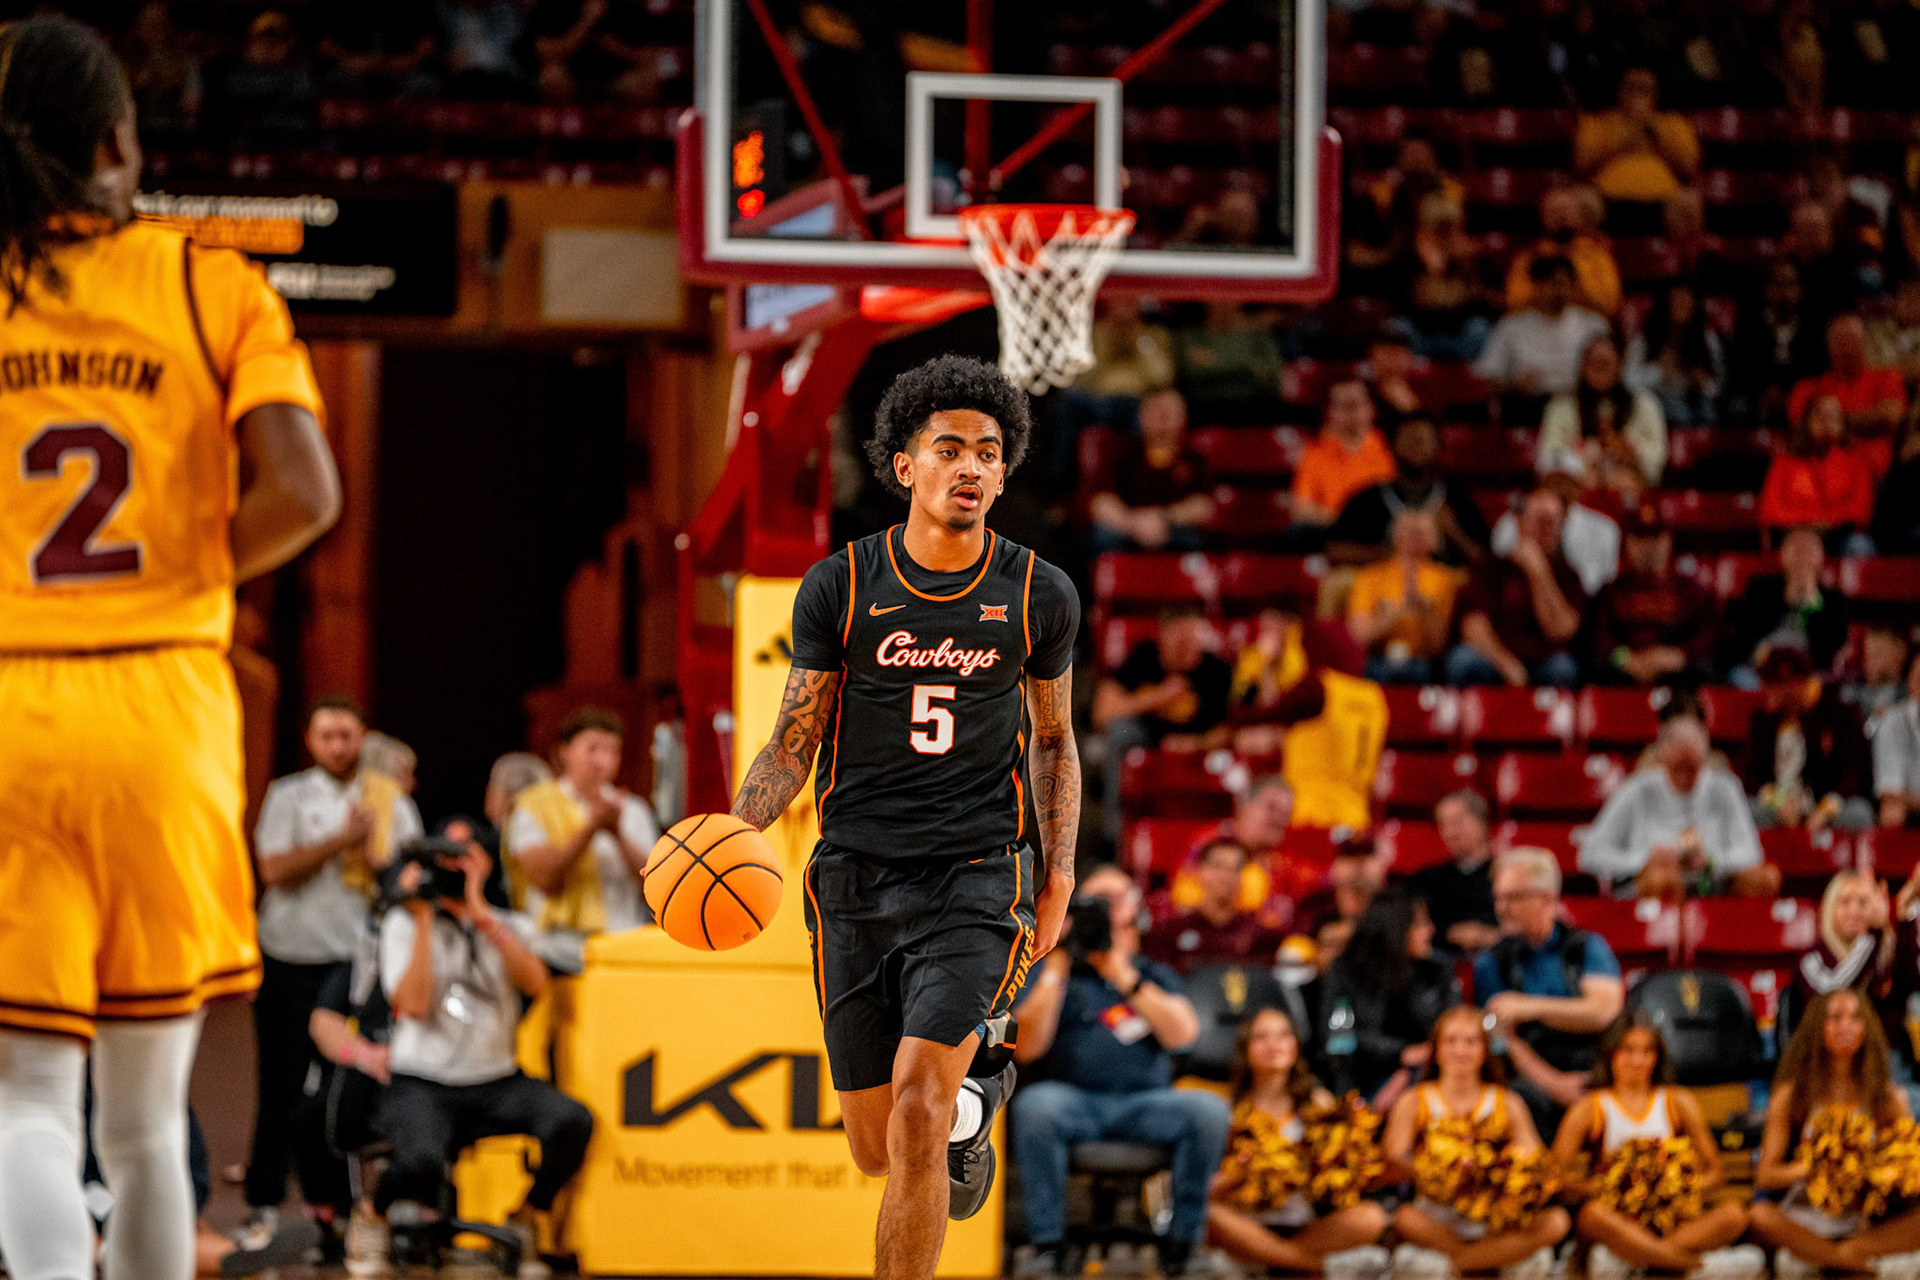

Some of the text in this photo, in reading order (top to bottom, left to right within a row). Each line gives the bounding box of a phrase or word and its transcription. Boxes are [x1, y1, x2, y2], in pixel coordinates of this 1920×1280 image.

[0, 349, 164, 397] OHNSON
[22, 423, 142, 583] 2
[876, 630, 1001, 677] Cowboys
[909, 684, 956, 755] 5
[1005, 923, 1036, 1009] POKES
[620, 1047, 846, 1132] KI
[613, 1155, 778, 1189] Movement
[786, 1159, 848, 1189] that
